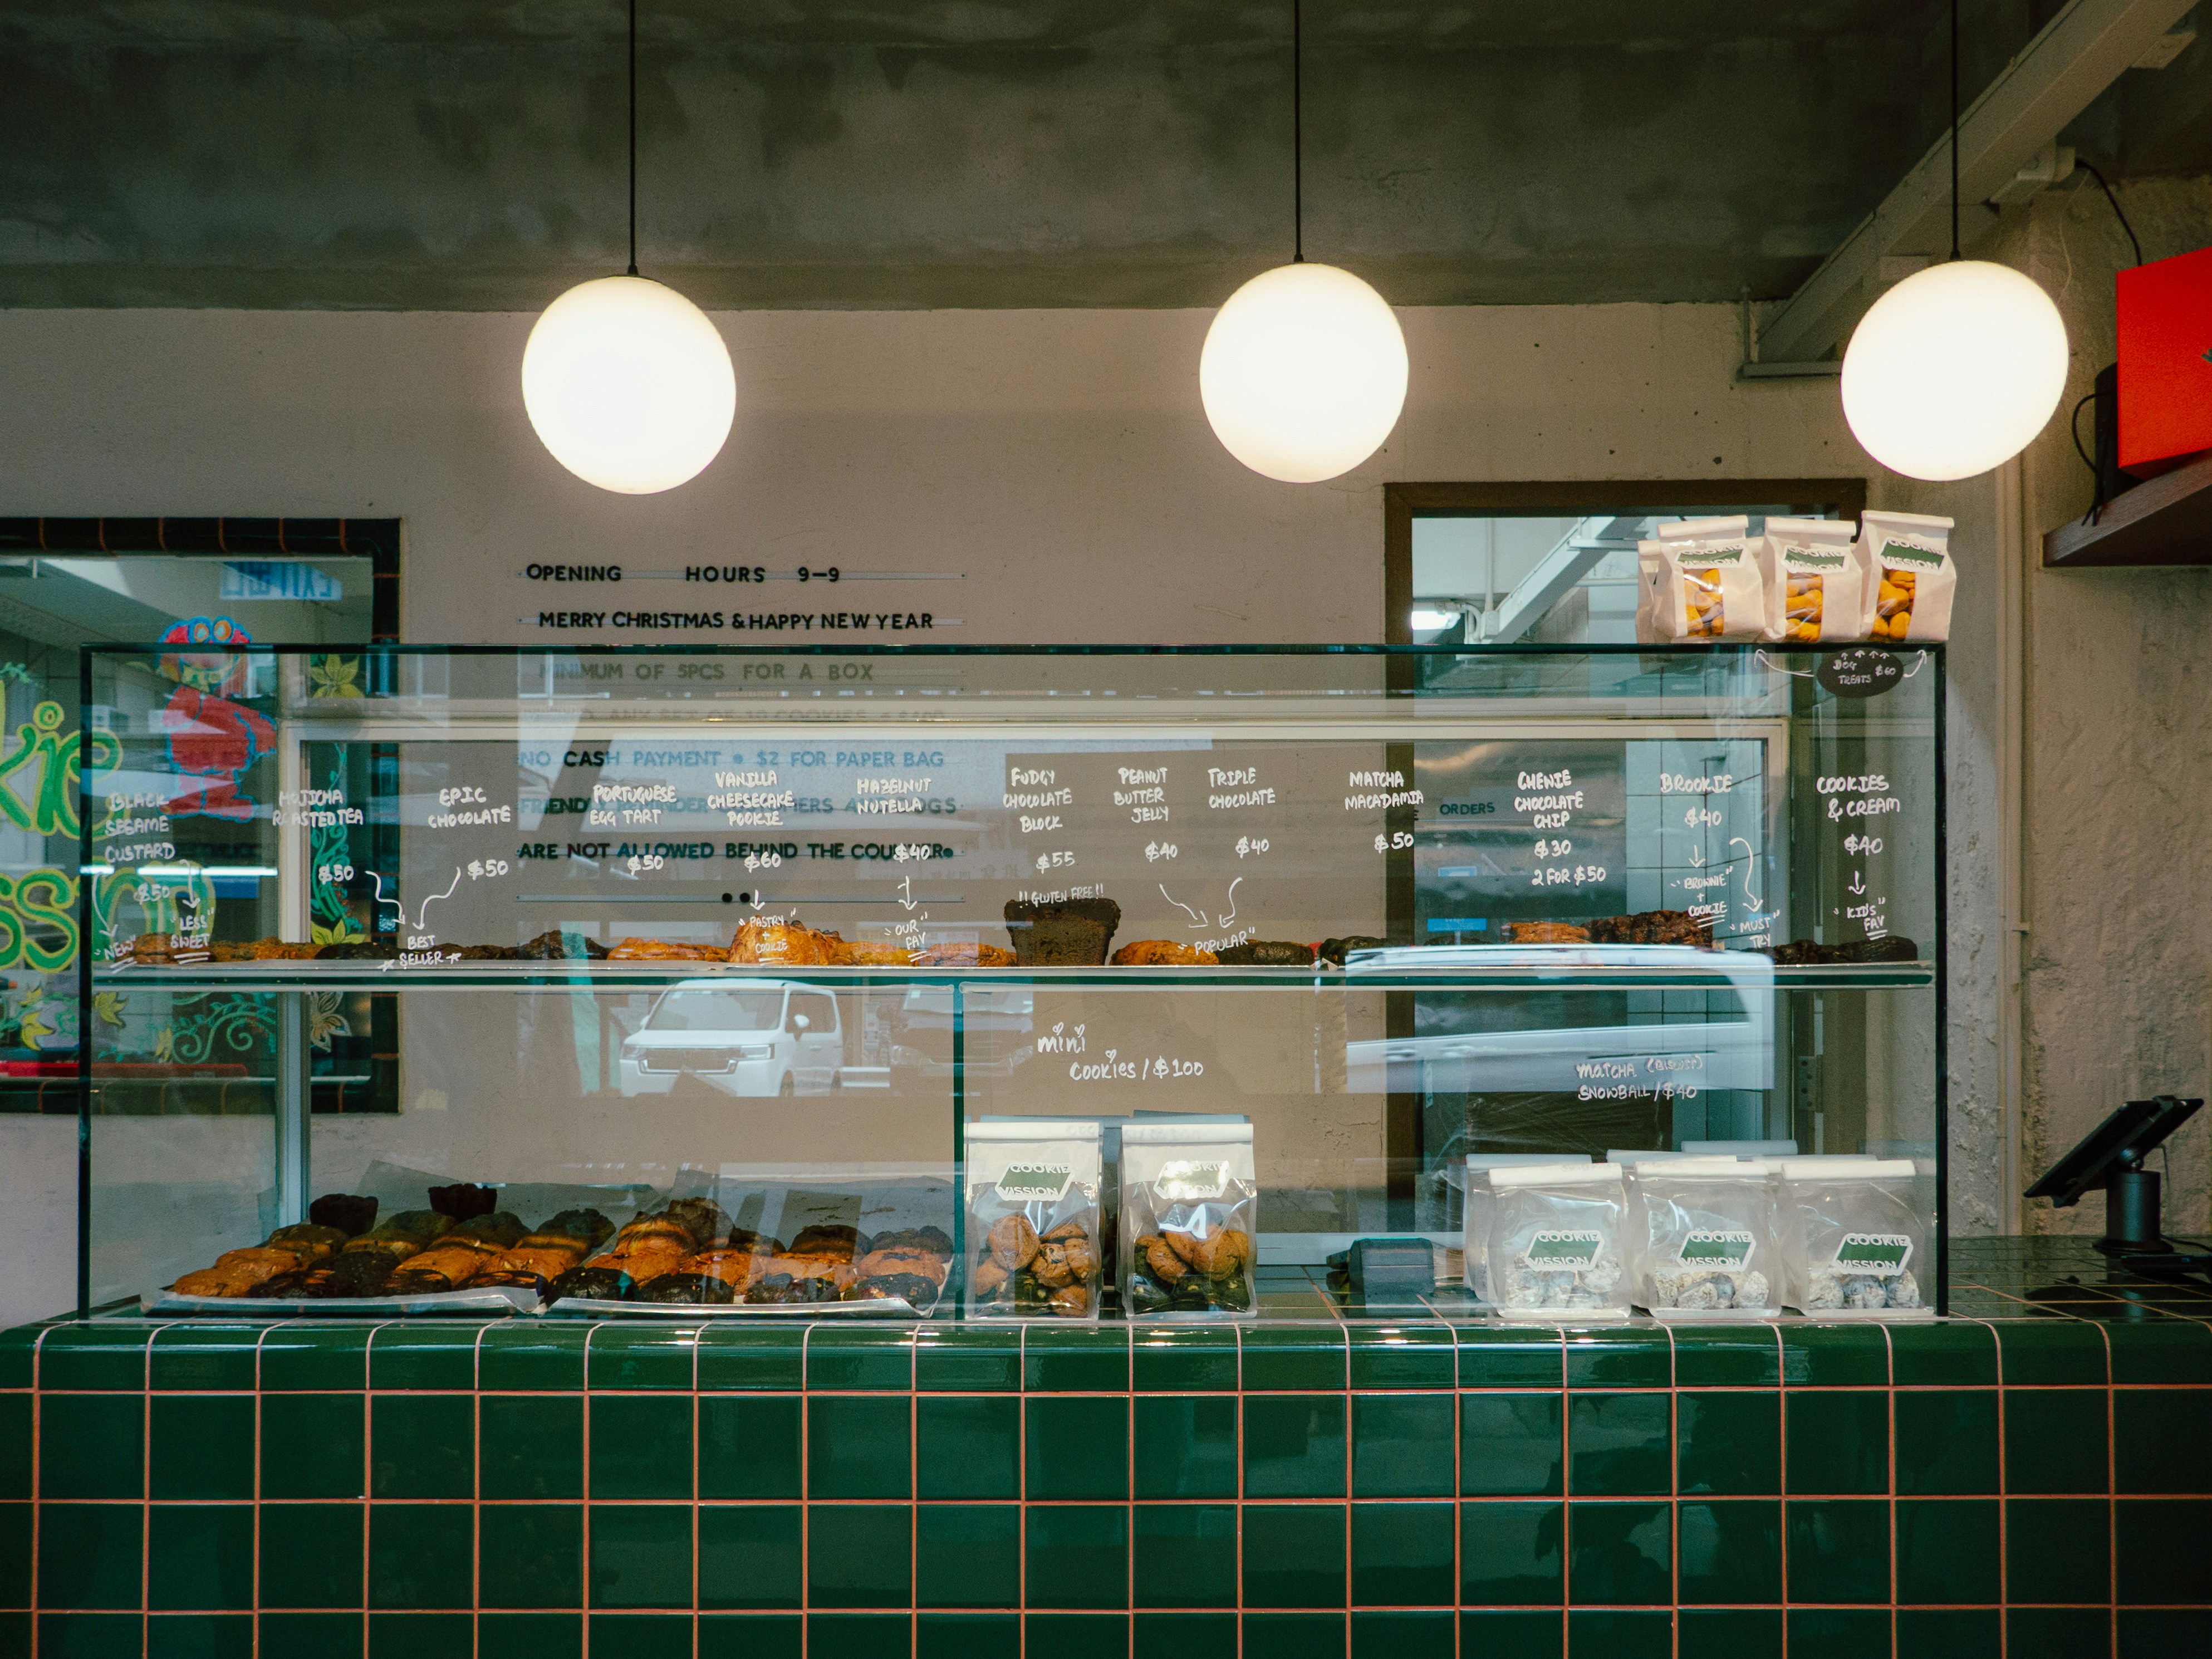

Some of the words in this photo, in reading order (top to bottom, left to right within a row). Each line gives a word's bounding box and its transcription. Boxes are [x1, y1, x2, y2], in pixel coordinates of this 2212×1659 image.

[527, 564, 622, 582] OPENING
[686, 566, 766, 582] HOURS
[539, 612, 606, 628] MERRY
[612, 611, 724, 629] CHRISTMAS
[821, 613, 870, 629] NEW
[876, 613, 933, 630] YEAR
[636, 664, 664, 679] OF
[743, 664, 785, 680] FOR
[799, 664, 813, 680] A
[829, 663, 873, 680] BOX
[1833, 659, 1857, 670] DOG
[1875, 664, 1896, 677] $60
[1838, 675, 1871, 685] TREATS
[519, 751, 551, 767] NO
[563, 751, 620, 767] CASH
[634, 751, 721, 767] PAYMENT
[757, 750, 778, 767] $2
[791, 752, 827, 767] FOR
[836, 752, 894, 767] PAPER
[904, 752, 944, 767] BAG
[715, 770, 777, 788] VANILLA
[1011, 767, 1055, 787] FUDGY
[1118, 767, 1168, 785] PEANUT
[1208, 767, 1256, 788] TRIPLE
[1349, 770, 1404, 788] MATCHA
[1517, 769, 1571, 790] CHEWIE
[1660, 773, 1732, 794] BROOKIE
[1816, 774, 1889, 794] COOKIES
[592, 784, 678, 804] PORTUGUESE
[857, 777, 933, 795] HAZELNUT
[111, 792, 169, 812] BLACK
[439, 787, 487, 807] EPIC
[708, 790, 795, 809] CHEESECAKE
[857, 797, 922, 814] NUTELLA
[1002, 788, 1072, 808] CHOCOLATE
[1114, 787, 1164, 806] BUTTER
[1209, 788, 1276, 809] CHOCOLATE
[1345, 790, 1424, 810] MACADAMIA
[1514, 792, 1583, 812] CHOCOLATE
[337, 808, 363, 825] TEA
[428, 806, 511, 828] CHOCOLATE
[590, 809, 616, 826] EGG
[622, 809, 662, 824] TART
[1131, 807, 1169, 823] JELLY
[1440, 802, 1495, 816] ORDERS
[1684, 807, 1722, 828] $40
[1827, 798, 1842, 822] &
[1846, 798, 1900, 817] CREAM
[105, 816, 169, 836] SESAME
[727, 811, 783, 827] POOKIE
[1020, 815, 1062, 833] BLOCK
[1533, 811, 1570, 829] CHIP
[518, 843, 558, 859] ARE
[567, 843, 610, 858] NOT
[617, 843, 714, 859] ALLOWED
[725, 843, 798, 859] BEHIND
[807, 843, 844, 859] THE
[1145, 841, 1178, 862] $40
[1235, 836, 1269, 858] $40
[1374, 832, 1414, 853] $50
[1534, 839, 1571, 859] $30
[1844, 834, 1883, 856] $40
[105, 842, 175, 862] CUSTARD
[893, 843, 931, 863] $40
[468, 859, 509, 880] $50
[627, 855, 664, 876] $50
[744, 852, 782, 873] $60
[1036, 851, 1075, 874] $55
[318, 864, 354, 884] $50
[1532, 869, 1544, 886] 2
[1546, 868, 1570, 884] FOR
[1574, 865, 1606, 886] $50
[134, 883, 170, 905] $50
[1688, 902, 1728, 918] COOKIE
[1863, 915, 1885, 931] FAV
[170, 934, 211, 949] SWEET
[408, 935, 436, 950] BEST
[755, 939, 788, 954] COOKIE
[906, 932, 926, 950] FAV
[1749, 934, 1772, 948] TRY
[399, 951, 444, 967] SELLER
[1009, 1164, 1071, 1174] COOKIE
[999, 1186, 1058, 1196] VISSION
[1537, 1232, 1600, 1242] COOKIE
[1689, 1233, 1753, 1243] COOKIE
[1846, 1235, 1907, 1246] COOKIE
[1528, 1256, 1591, 1267] VISSION
[1680, 1256, 1743, 1267] VISSION
[1836, 1259, 1898, 1270] VISSION
